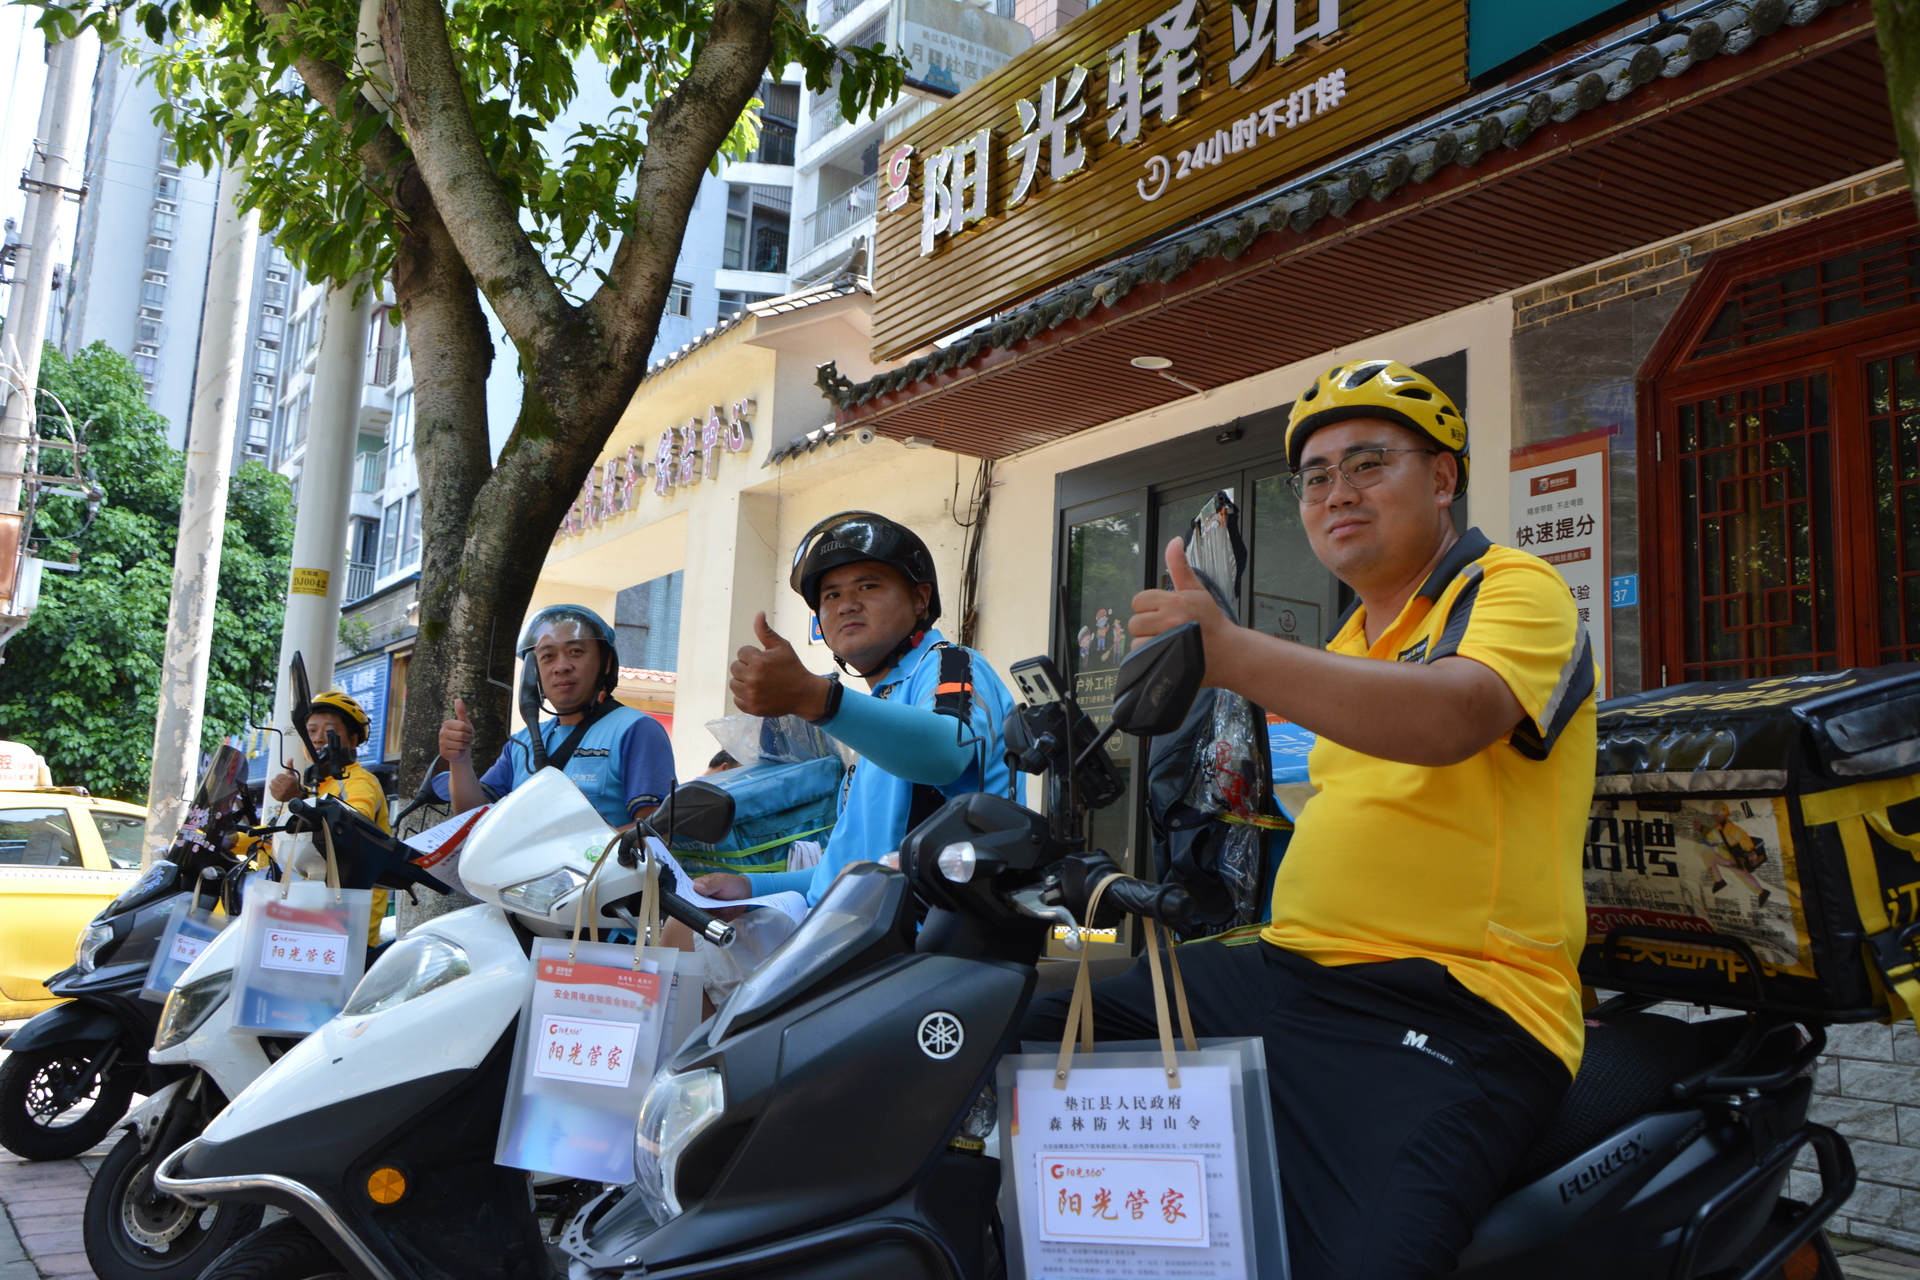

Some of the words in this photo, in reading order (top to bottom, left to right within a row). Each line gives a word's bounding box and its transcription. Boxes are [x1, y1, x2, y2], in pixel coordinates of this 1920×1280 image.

[919, 0, 1341, 258] 阳光驿站
[1176, 68, 1348, 181] 24小时不打烊
[1556, 497, 1584, 511] 不走弯路
[1516, 513, 1596, 548] 快速提分
[294, 578, 327, 588] DJ0042
[1613, 589, 1628, 603] 37
[1583, 817, 1680, 878] 招聘
[271, 944, 337, 965] 阳光管家
[554, 988, 638, 1010] 安全用电应知应会知识
[548, 1040, 623, 1071] 阳光管家
[1064, 1094, 1183, 1112] 垫江县人民政府
[1049, 1115, 1202, 1132] 森林防火封山令
[1057, 1187, 1187, 1224] 阳光管家
